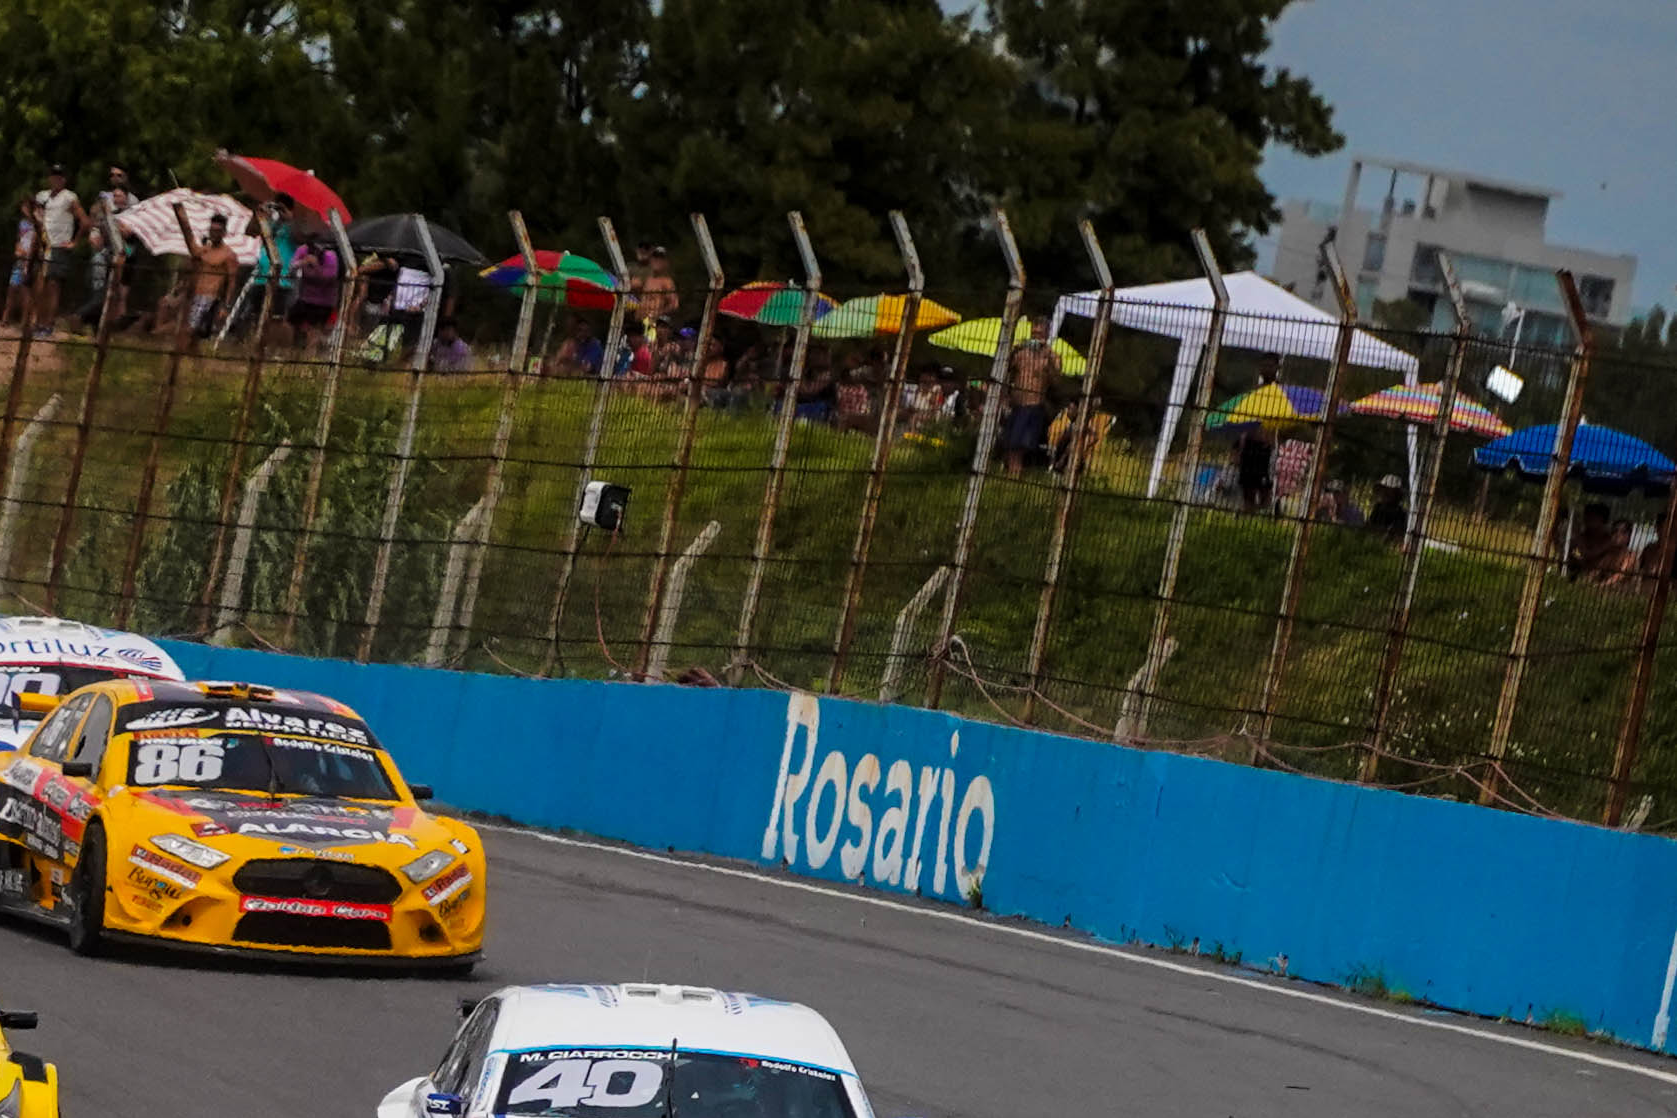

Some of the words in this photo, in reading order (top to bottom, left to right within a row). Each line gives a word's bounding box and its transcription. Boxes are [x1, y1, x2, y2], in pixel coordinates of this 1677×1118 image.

[134, 742, 225, 785] 86
[761, 692, 994, 900] Rosario
[520, 1053, 544, 1063] M.
[509, 1058, 663, 1108] 40
